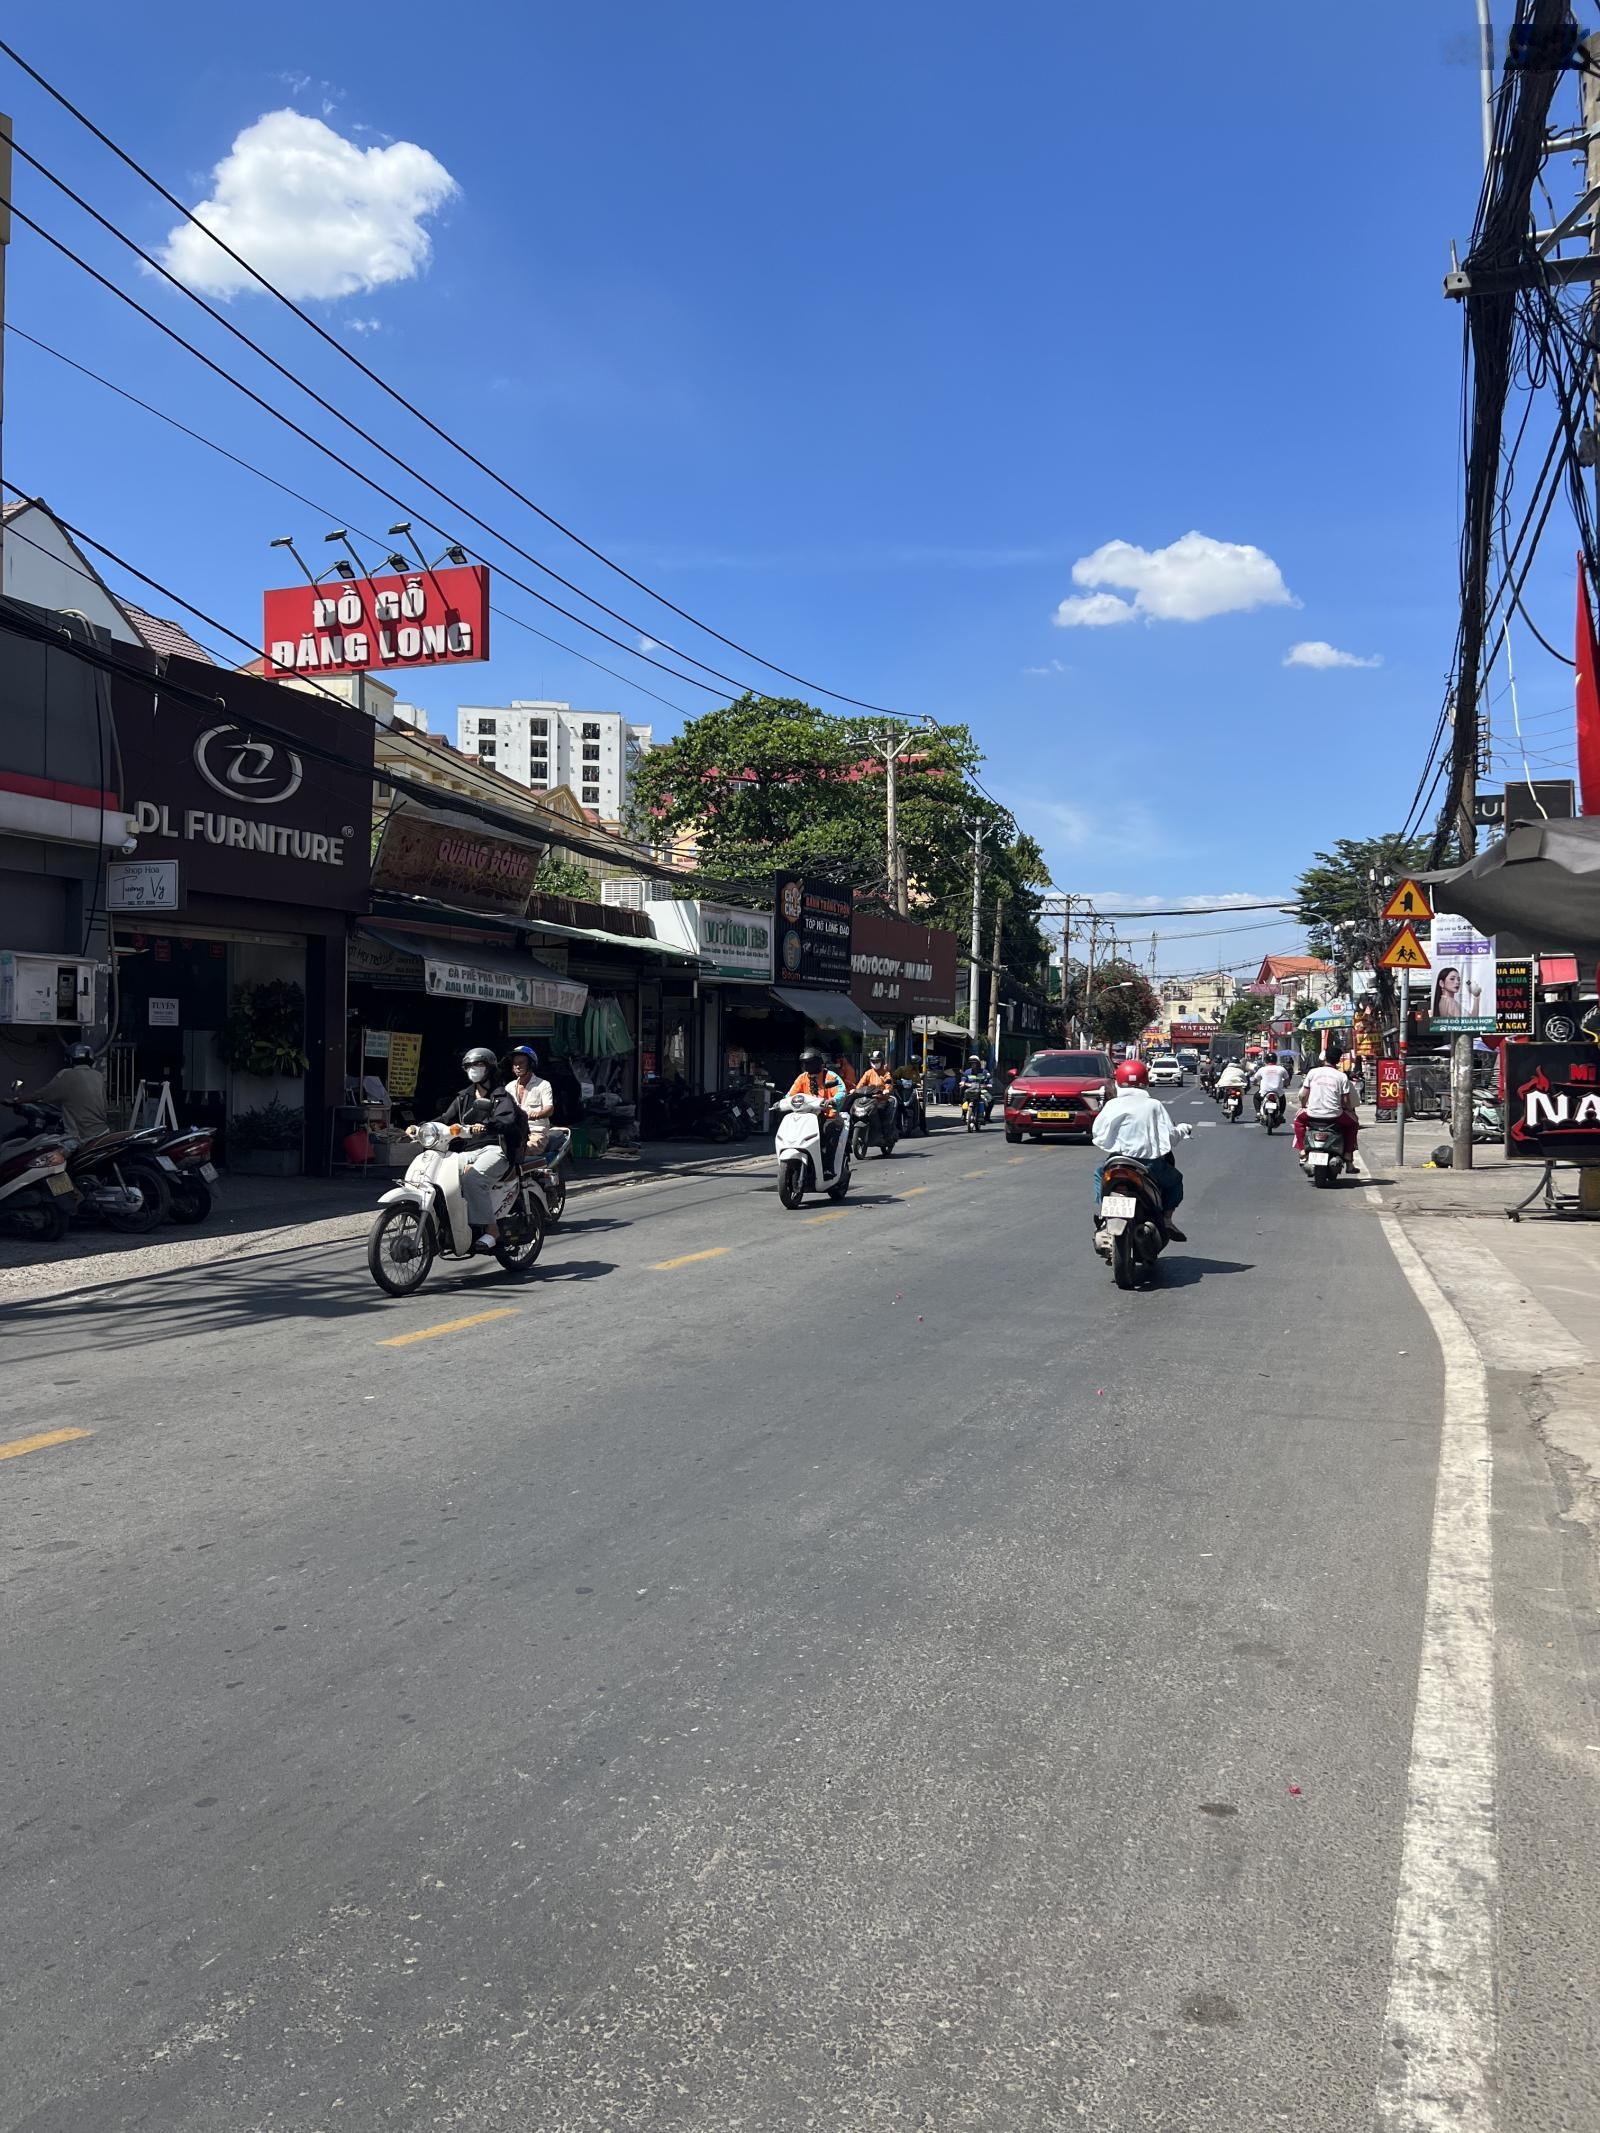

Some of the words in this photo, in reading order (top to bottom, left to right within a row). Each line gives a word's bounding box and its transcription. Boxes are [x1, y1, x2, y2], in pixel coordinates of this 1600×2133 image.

[312, 584, 362, 628] ĐỒ
[375, 577, 425, 621] GỖ
[270, 632, 369, 670] ĐĂNG
[379, 622, 472, 660] LONG
[134, 800, 178, 838] DL
[184, 810, 344, 866] FURNITURE
[125, 867, 143, 875] Shop
[145, 866, 159, 874] Hoa
[151, 875, 164, 900] Vy
[448, 967, 459, 979] CÀ
[461, 968, 478, 981] PHÊ
[904, 962, 915, 979] IN
[463, 982, 476, 994] MÁ
[478, 985, 494, 998] ĐẬU
[495, 988, 516, 1001] XANH
